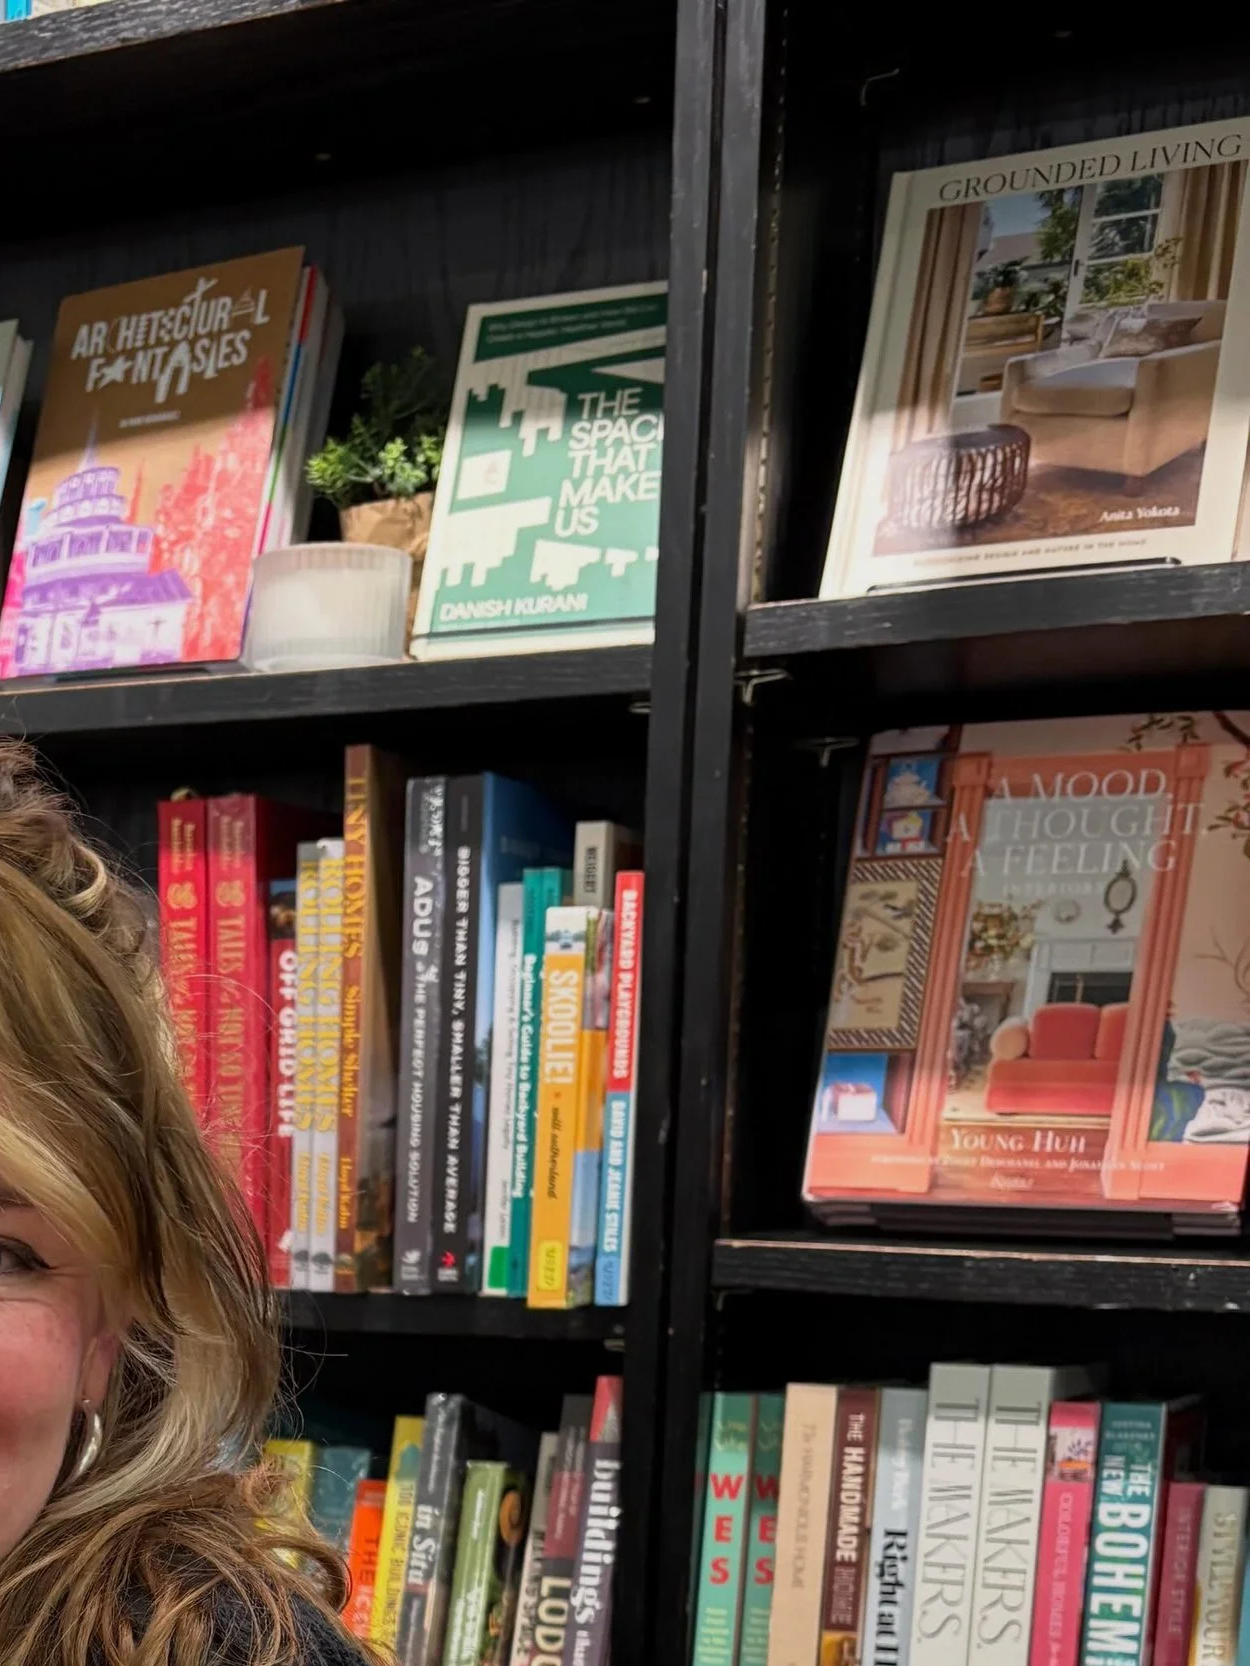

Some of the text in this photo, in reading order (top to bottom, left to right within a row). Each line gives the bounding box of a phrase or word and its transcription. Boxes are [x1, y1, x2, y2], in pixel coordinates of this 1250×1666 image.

[939, 133, 1243, 203] GROUNDED LIVING
[568, 413, 664, 451] SPAC
[576, 387, 643, 421] THE
[567, 442, 655, 479] THAT
[554, 505, 600, 538] US
[1100, 505, 1181, 523] Anita Yokota
[439, 593, 588, 622] DANISH KURANI
[991, 767, 1176, 804] A MOOD,
[945, 802, 1209, 842] A THOUGHT,
[960, 840, 1179, 878] A FEELING
[298, 860, 321, 1004] ROLLING
[319, 856, 345, 1004] ROLLING
[344, 852, 367, 959] HOMES
[217, 915, 246, 974] TALES
[519, 953, 537, 1022] Beginner's
[611, 888, 638, 1079] BACKYARD PLAYGROUNDS
[277, 949, 298, 1138] OFF GRID LIFE
[341, 985, 361, 1044] Simple
[443, 846, 471, 1234] BIGGER THAN TINY, SMALLER THAN AVERAGE
[518, 1025, 535, 1063] Guide
[543, 969, 579, 1084] SKOOLIE!
[295, 1015, 318, 1132] HOMES
[313, 1016, 340, 1132] HOMES
[339, 1053, 360, 1117] Shelter
[518, 1066, 532, 1080] to
[406, 1009, 427, 1223] PERFECT HOUSING SOLUTION
[515, 1082, 532, 1143] Backyard
[608, 1100, 625, 1143] DAVID
[950, 1128, 1087, 1153] YOUNG HUH
[512, 1145, 528, 1198] Building
[607, 1146, 623, 1166] AND
[603, 1212, 620, 1253] STILES
[932, 1400, 980, 1472] THE
[991, 1403, 1042, 1476] THE
[1101, 1455, 1153, 1497] THE NEW
[408, 1504, 442, 1585] in Situ
[570, 1459, 622, 1624] buildings
[831, 1413, 865, 1625] THE HANDMADE HOME
[876, 1529, 909, 1606] Right
[1206, 1511, 1239, 1593] STYLE
[572, 1629, 592, 1666] that
[875, 1611, 899, 1638] at
[1201, 1598, 1230, 1660] YOUR
